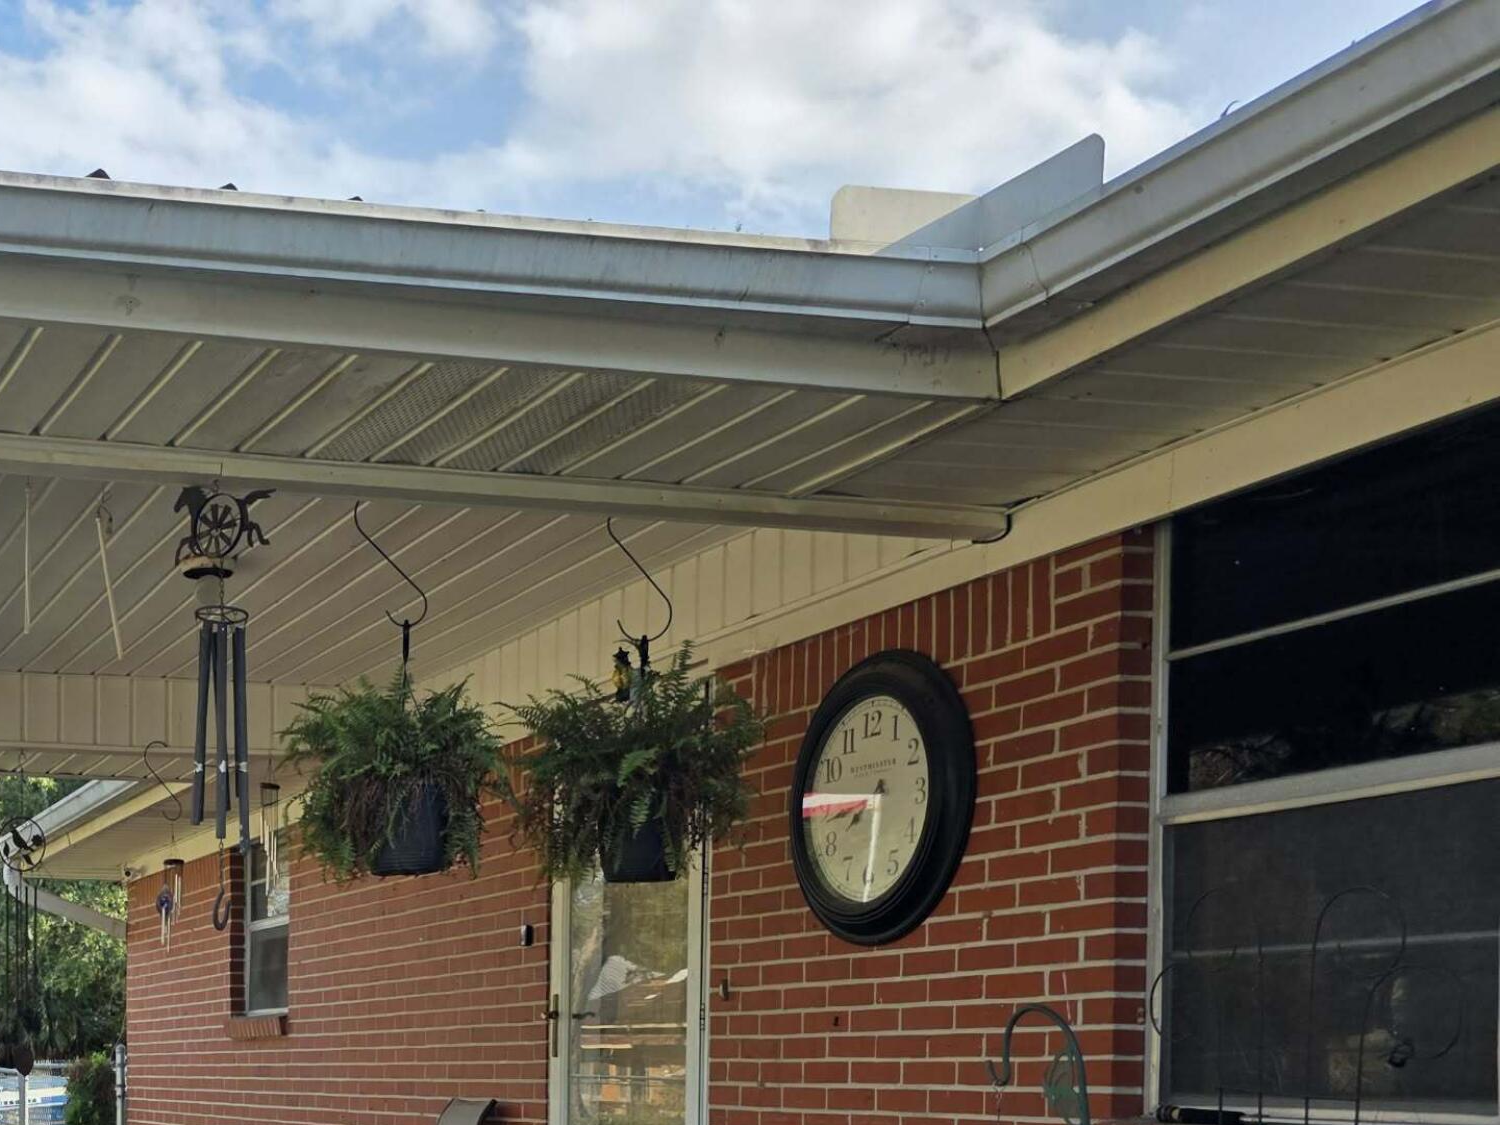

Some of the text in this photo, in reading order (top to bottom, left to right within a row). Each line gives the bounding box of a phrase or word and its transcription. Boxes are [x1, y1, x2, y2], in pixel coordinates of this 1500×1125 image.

[861, 710, 882, 739] 12
[891, 715, 900, 742] 1
[842, 728, 856, 755] 11
[907, 738, 919, 765] 2
[823, 756, 842, 784] 10
[914, 777, 926, 804] 3
[904, 816, 917, 844] 4
[825, 831, 837, 857] 8
[843, 855, 854, 881] 7
[887, 849, 899, 875] 5
